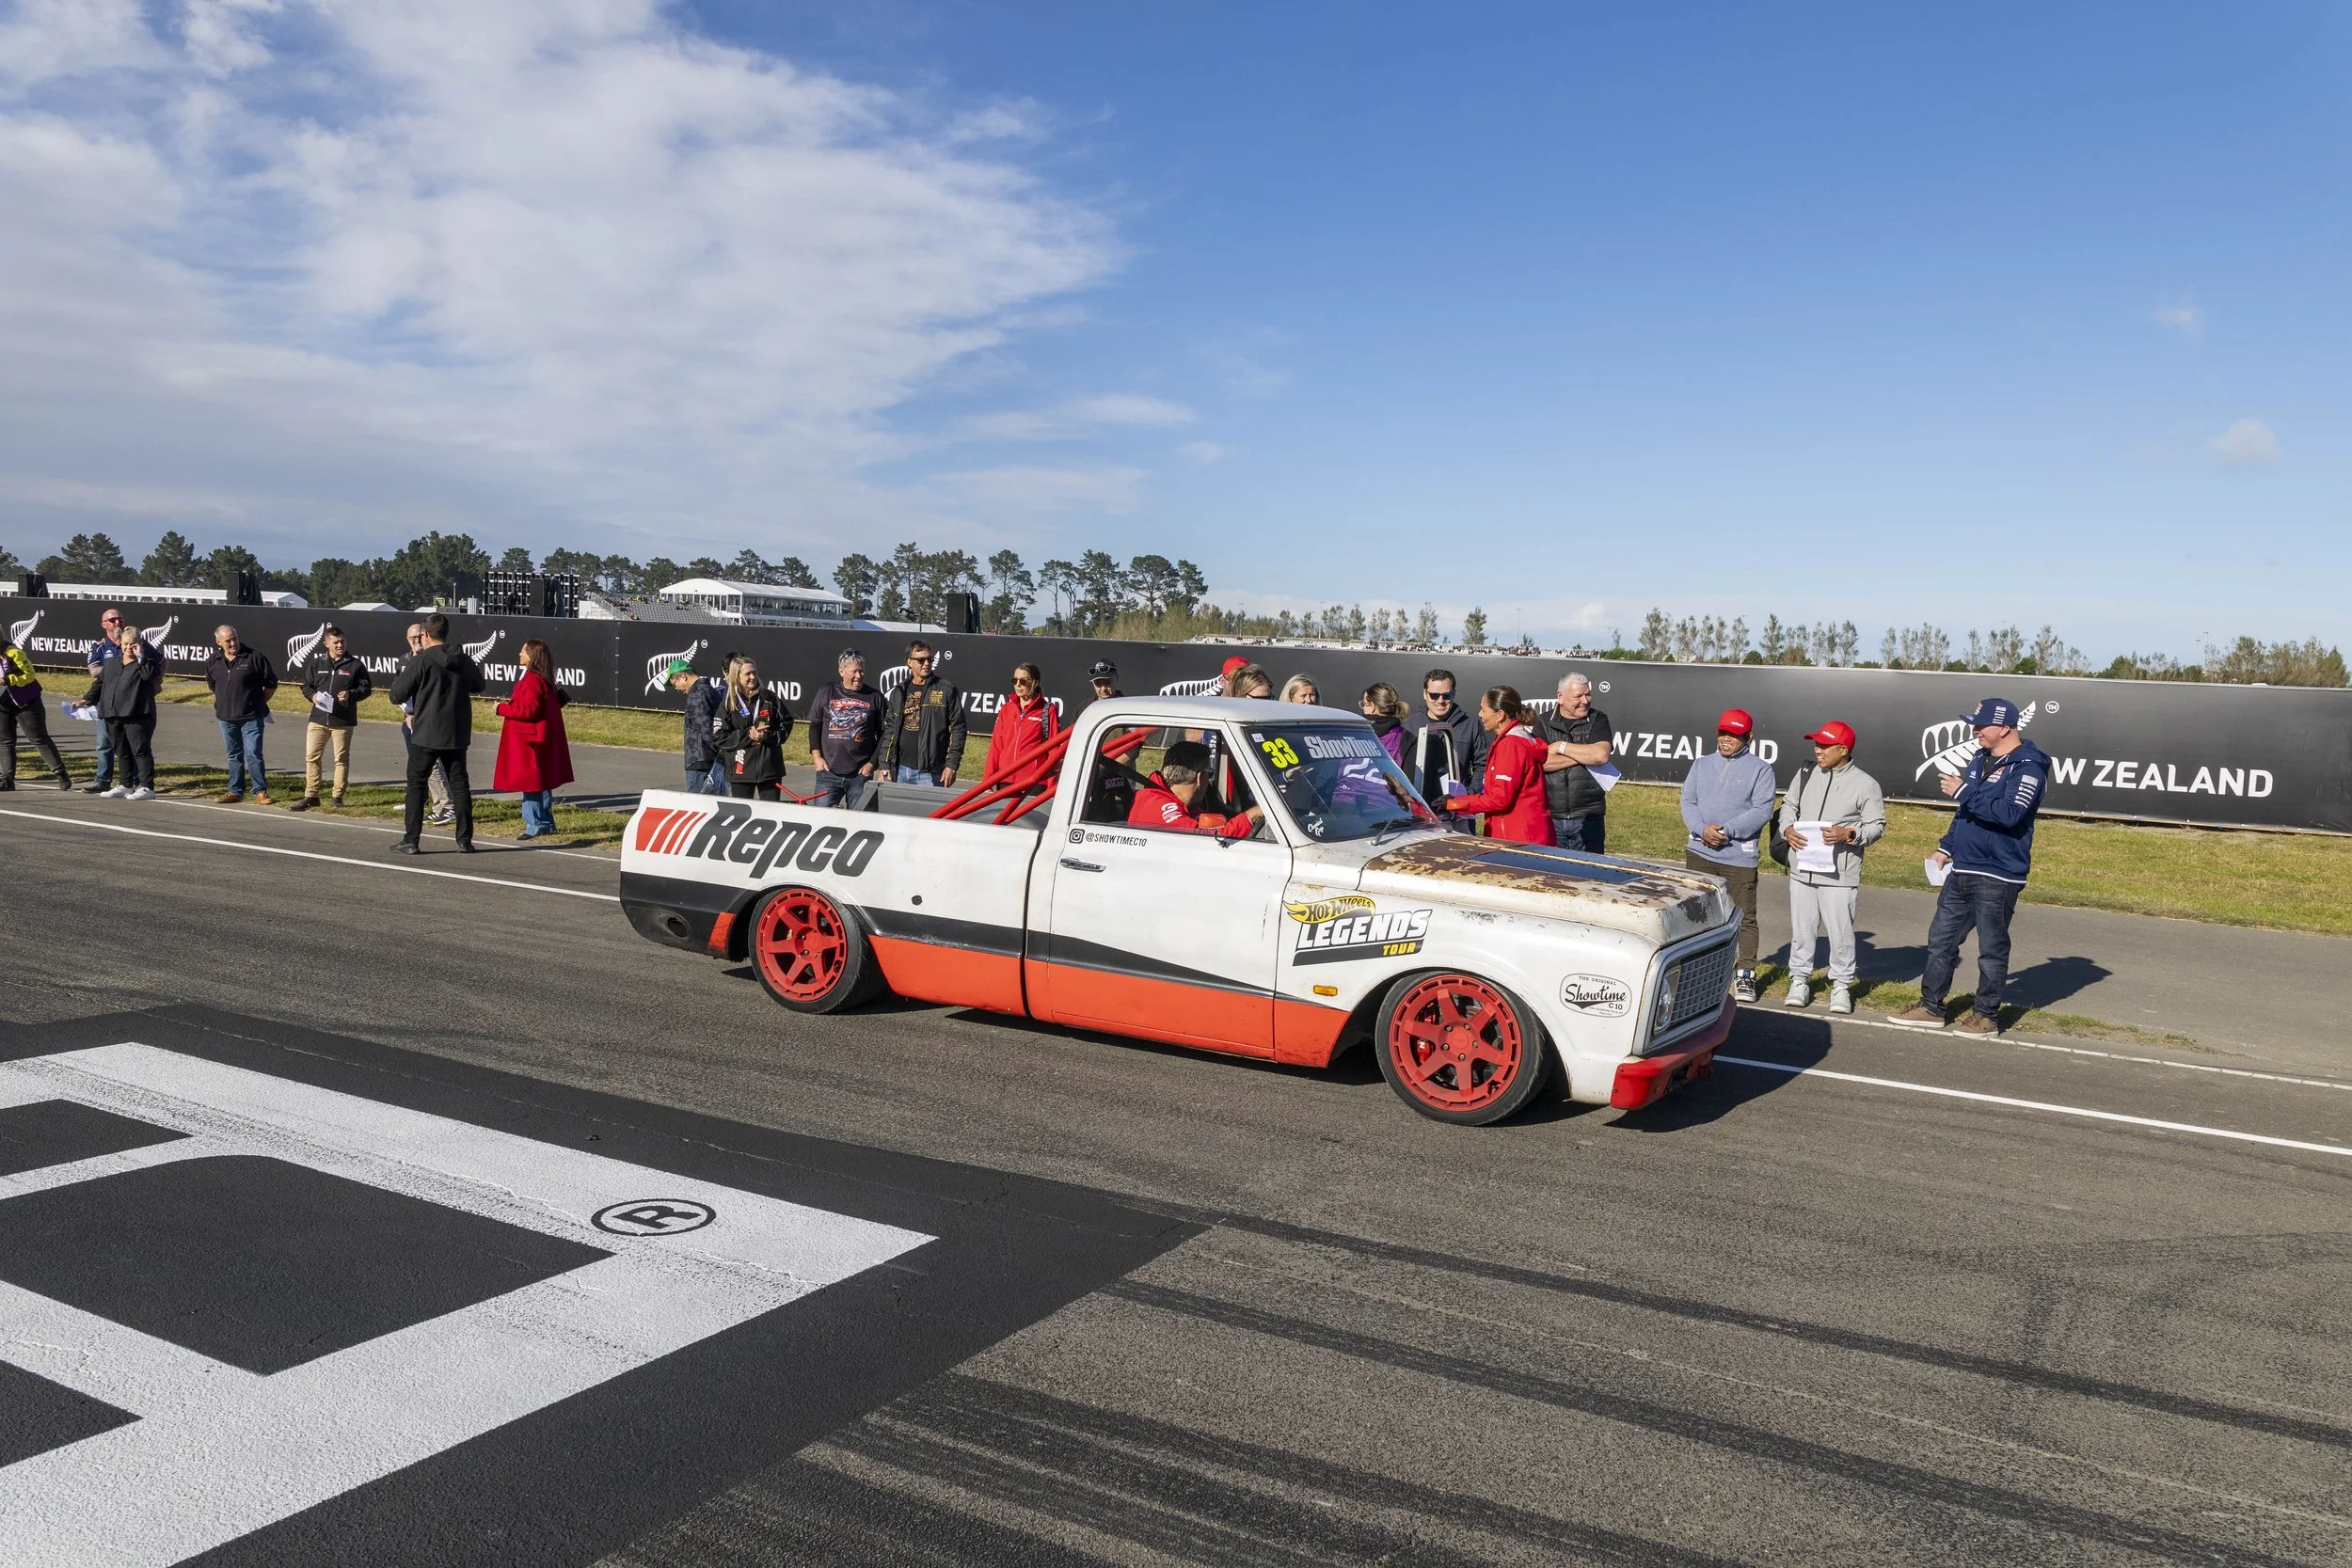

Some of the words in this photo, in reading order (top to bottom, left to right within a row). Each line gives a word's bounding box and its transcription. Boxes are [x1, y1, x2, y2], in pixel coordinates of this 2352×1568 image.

[31, 637, 53, 651] NEW
[164, 644, 188, 659] NEW
[485, 663, 517, 681] NEW
[1262, 737, 1299, 768] 33
[1303, 736, 1382, 759] ShowTime
[2091, 759, 2274, 798] ZEALAND
[685, 800, 885, 879] Repco
[1085, 832, 1148, 847] @SHOWTIMEC10
[1305, 903, 1331, 922] HOT
[1296, 910, 1433, 951] LEGENDS
[1382, 942, 1417, 957] TOUR
[1591, 977, 1617, 986] ORIGINAL
[1565, 983, 1628, 1003] Showtime
